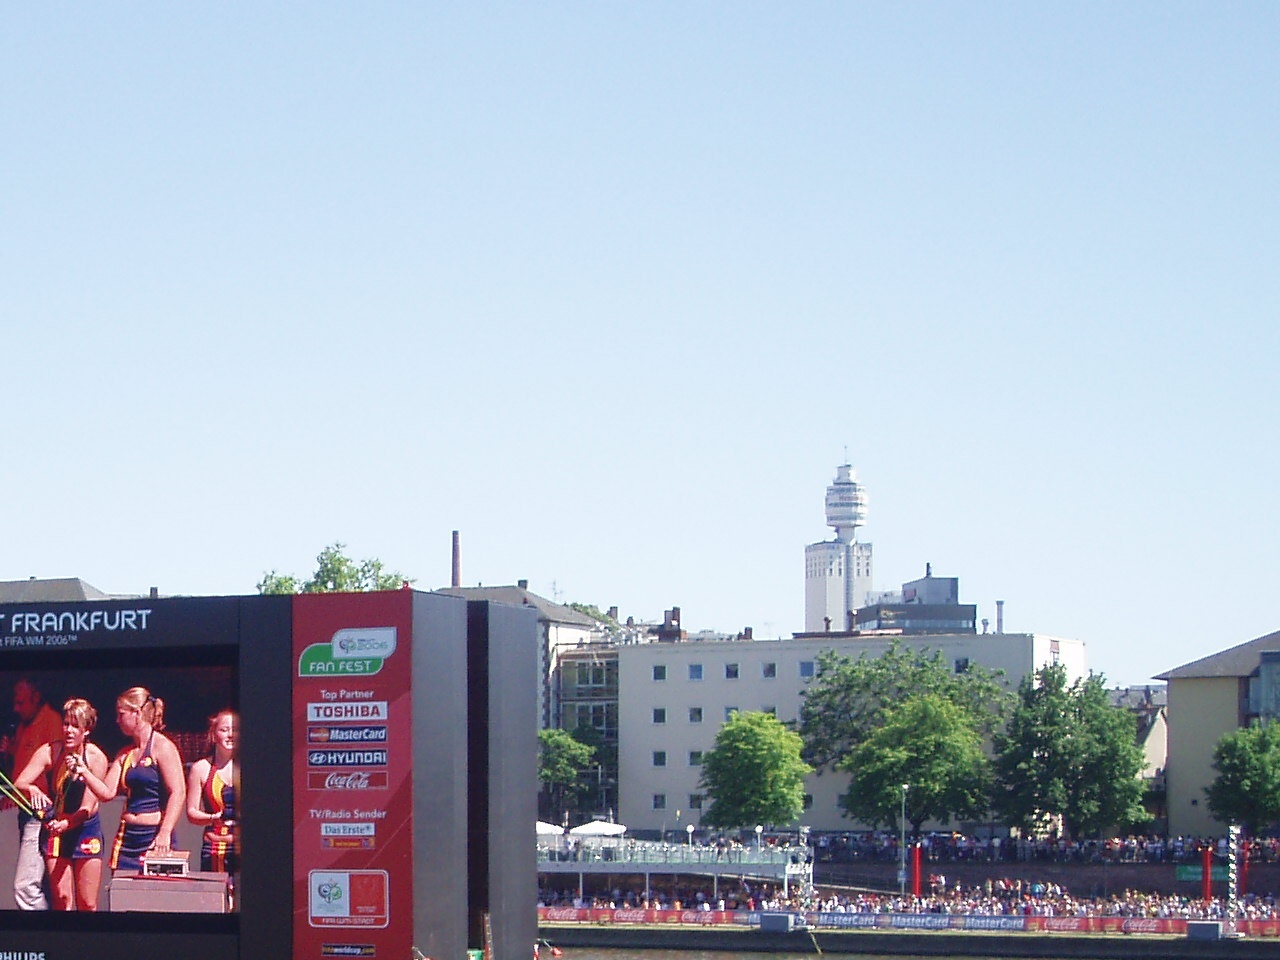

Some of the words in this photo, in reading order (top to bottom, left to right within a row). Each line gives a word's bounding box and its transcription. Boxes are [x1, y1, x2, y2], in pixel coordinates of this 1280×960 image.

[11, 609, 152, 633] FRANKFURT
[5, 636, 24, 646] FIFA
[25, 635, 44, 645] WM
[309, 662, 335, 672] FAN
[339, 660, 371, 672] FEST
[321, 690, 337, 700] Top
[340, 689, 374, 699] Partner
[314, 705, 380, 718] TOSHIBA
[330, 729, 386, 740] MasterCard
[328, 752, 386, 763] HYUNDAI
[310, 809, 351, 819] TV/Radio
[354, 809, 387, 818] Sender
[325, 826, 340, 834] Das
[820, 914, 875, 926] MasterCard
[892, 916, 949, 927] MasterCard
[966, 917, 1024, 929] MasterCard
